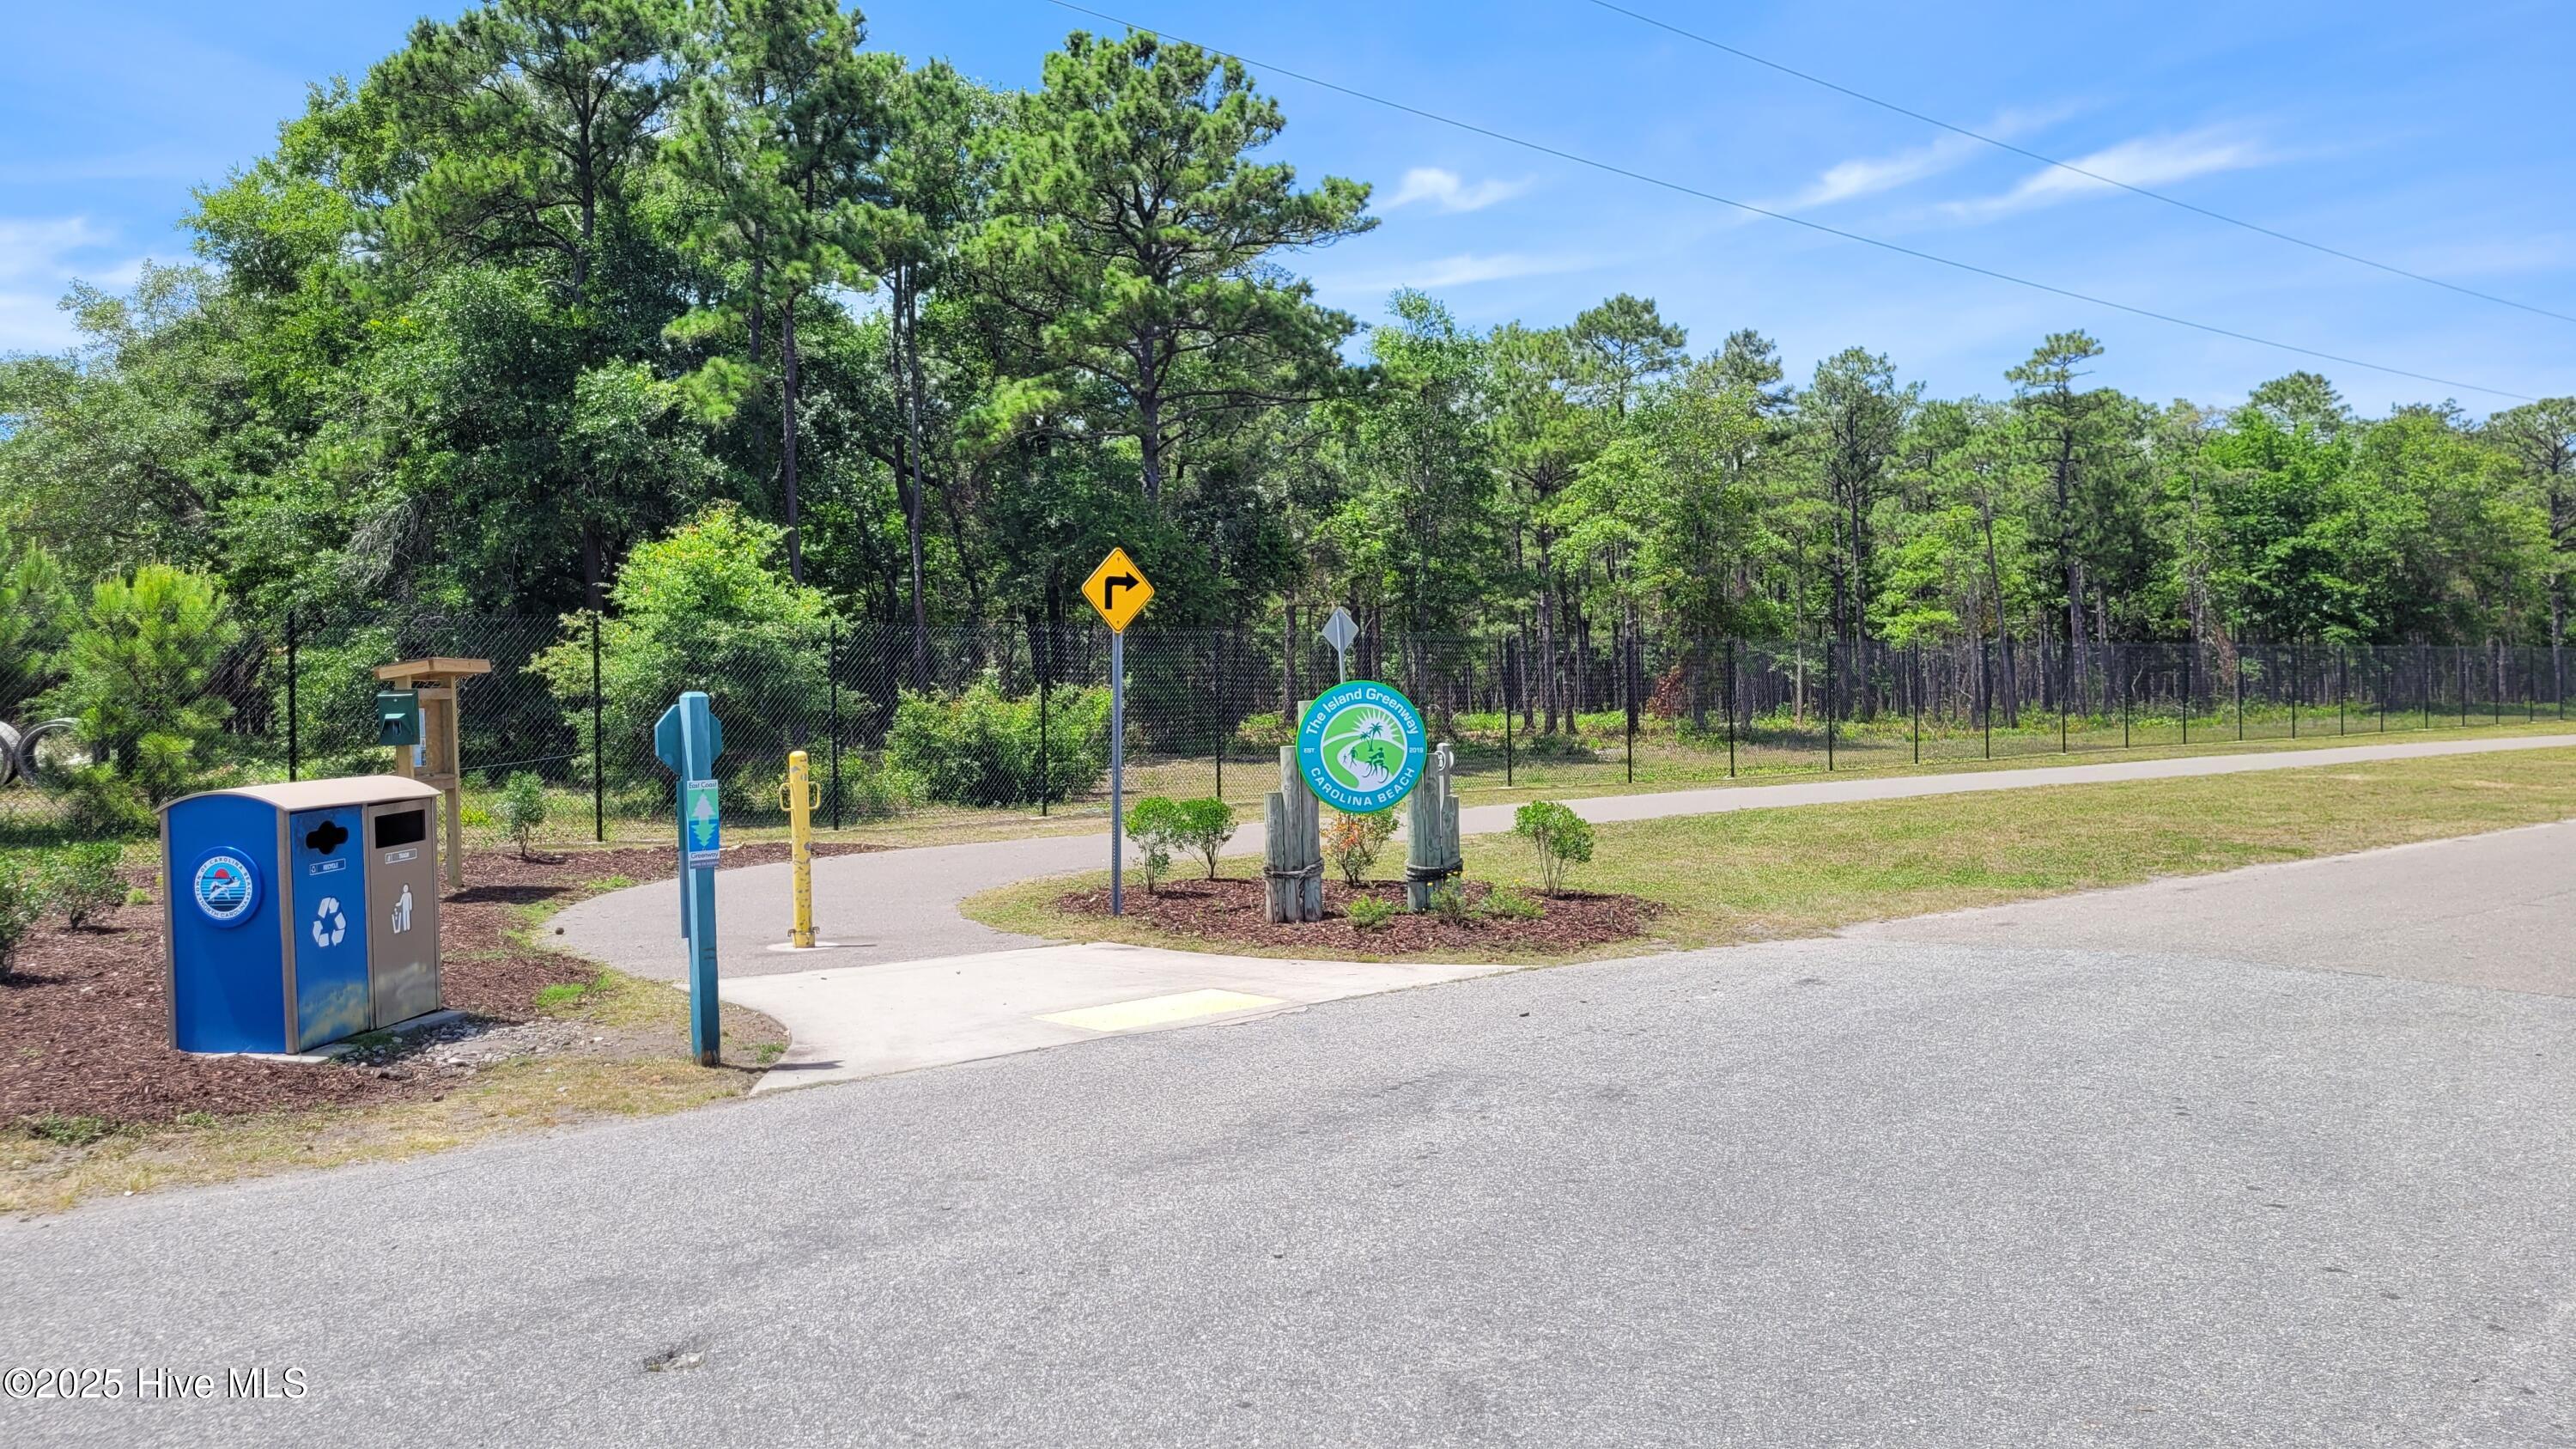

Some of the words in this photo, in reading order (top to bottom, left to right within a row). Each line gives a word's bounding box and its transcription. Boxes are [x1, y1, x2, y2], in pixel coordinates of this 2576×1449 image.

[1306, 712, 1326, 735] The
[1322, 688, 1363, 713] Island
[1365, 687, 1419, 735] Greenway
[1310, 767, 1373, 807] CAROLINA
[1377, 767, 1415, 803] BEACH
[690, 851, 719, 860] Greenway
[210, 857, 243, 870] CAROLINA
[323, 861, 339, 871] RECYCLE
[198, 900, 219, 917] NORTH
